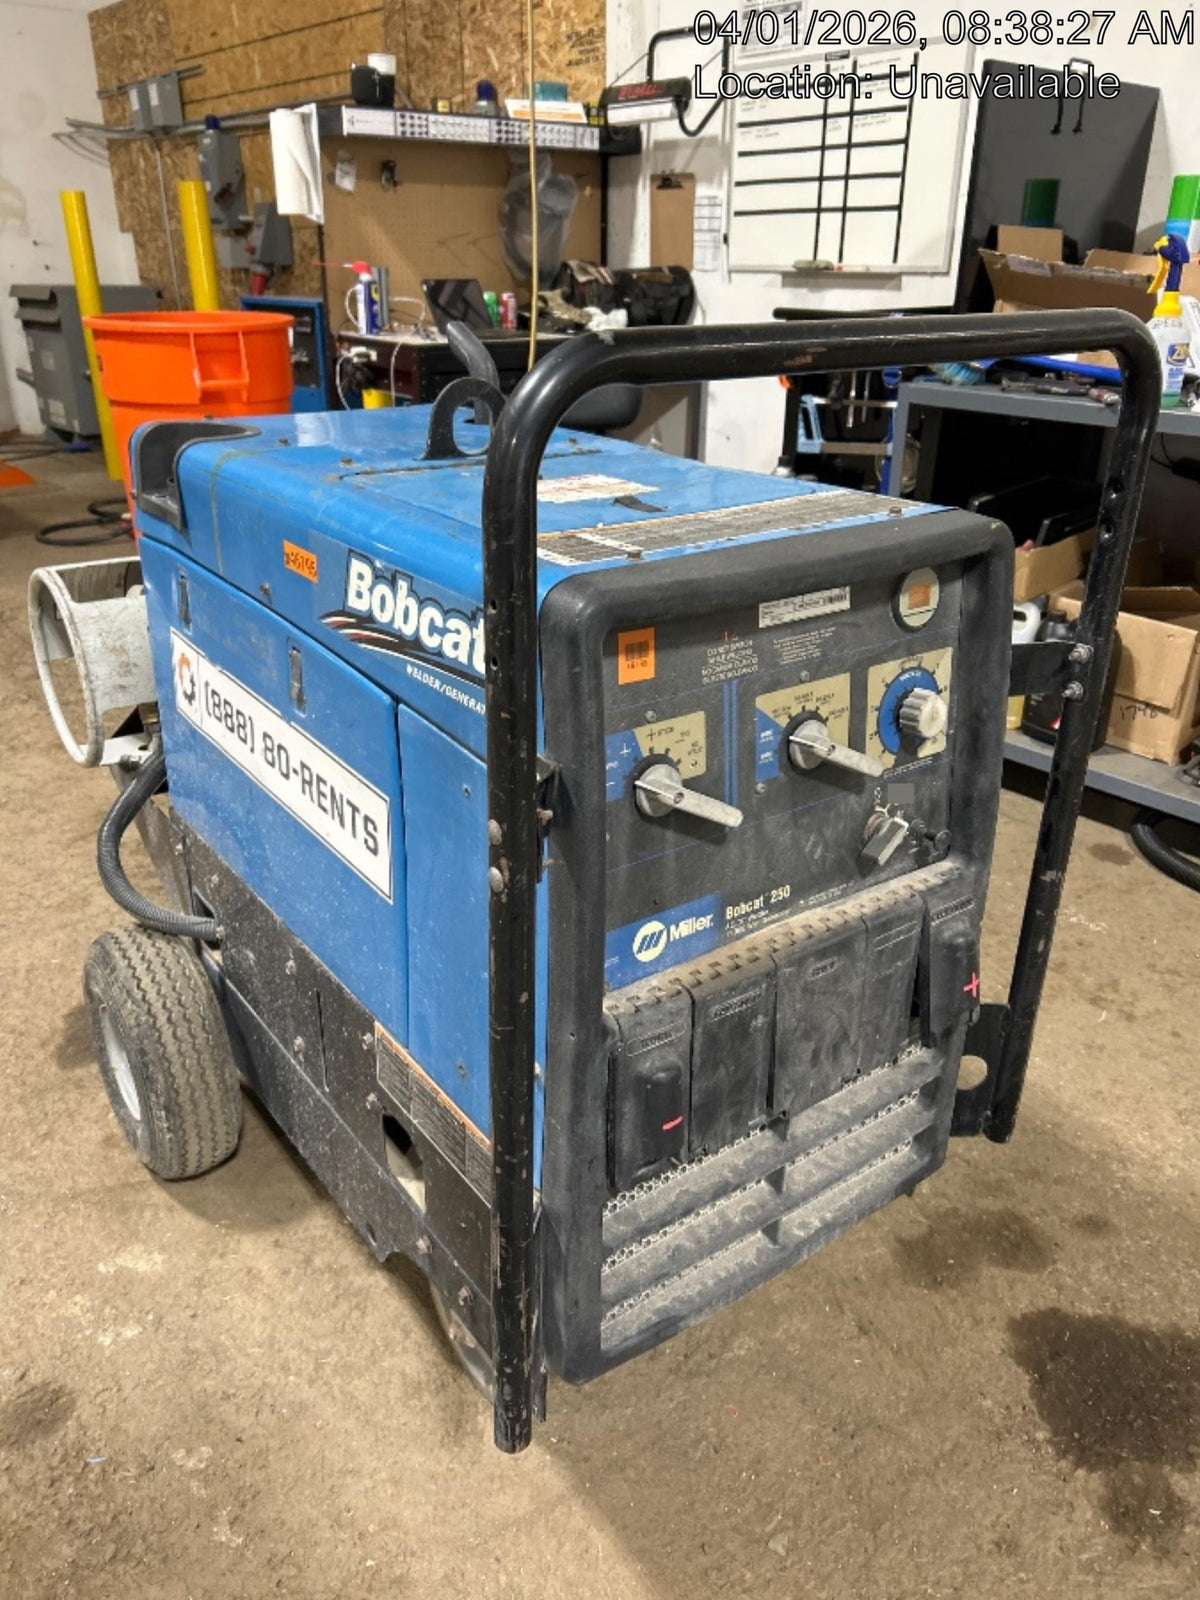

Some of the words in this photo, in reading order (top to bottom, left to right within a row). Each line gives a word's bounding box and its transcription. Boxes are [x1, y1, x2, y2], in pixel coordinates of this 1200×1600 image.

[347, 556, 486, 676] Bobcat
[204, 680, 256, 755] (888)
[262, 731, 380, 858] 80-RENTS
[725, 893, 764, 920] Bobcat
[770, 884, 791, 904] 250
